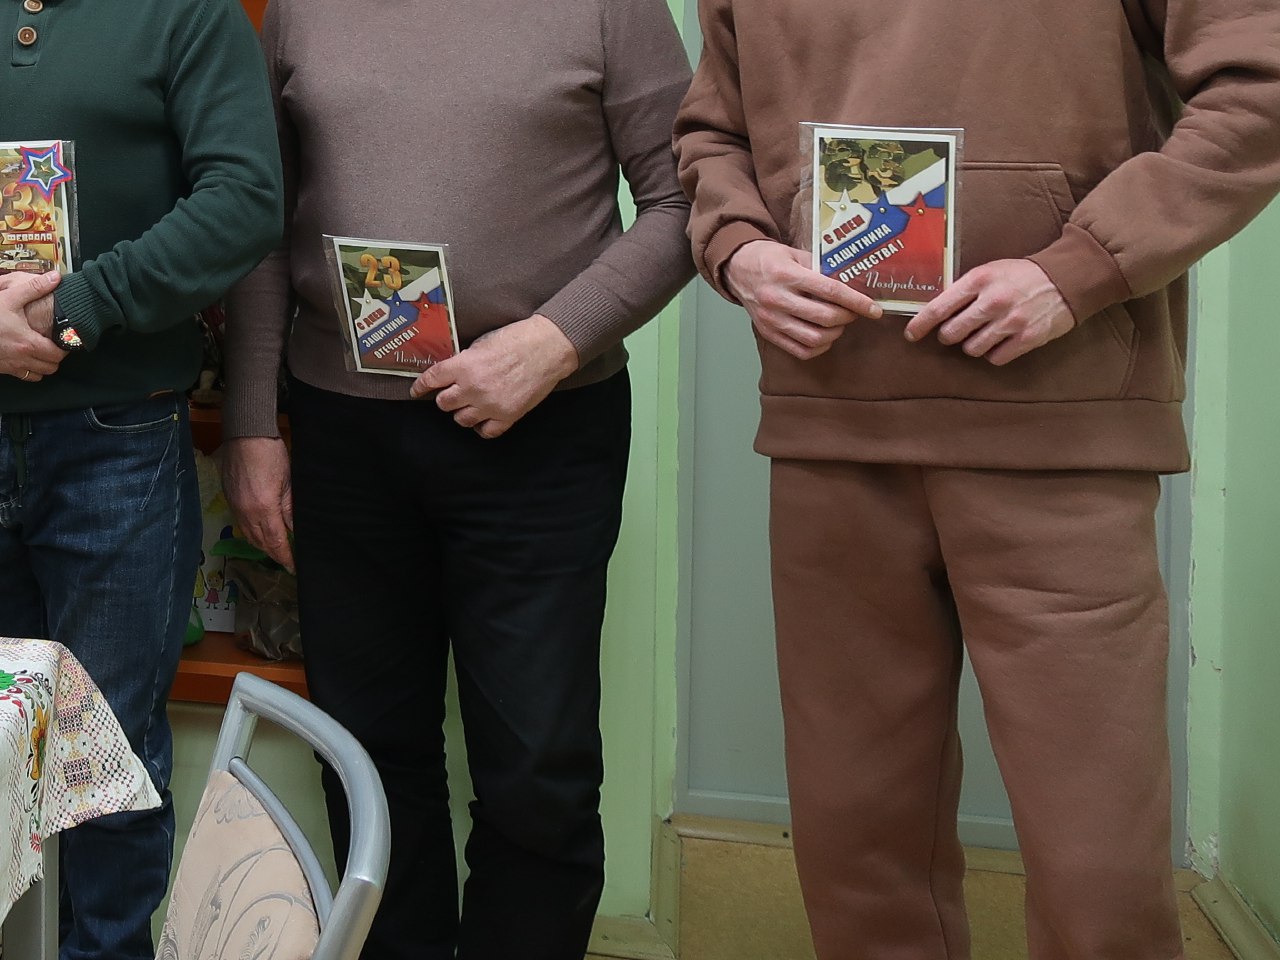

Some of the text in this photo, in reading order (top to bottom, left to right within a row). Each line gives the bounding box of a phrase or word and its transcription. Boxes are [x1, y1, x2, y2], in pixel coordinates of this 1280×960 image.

[823, 214, 865, 244] С ДНЕМ
[826, 224, 892, 268] ЗАЩИТНИКА
[360, 254, 402, 290] 23
[356, 322, 366, 330] С
[362, 315, 408, 348] ЗАЩИТНИКА
